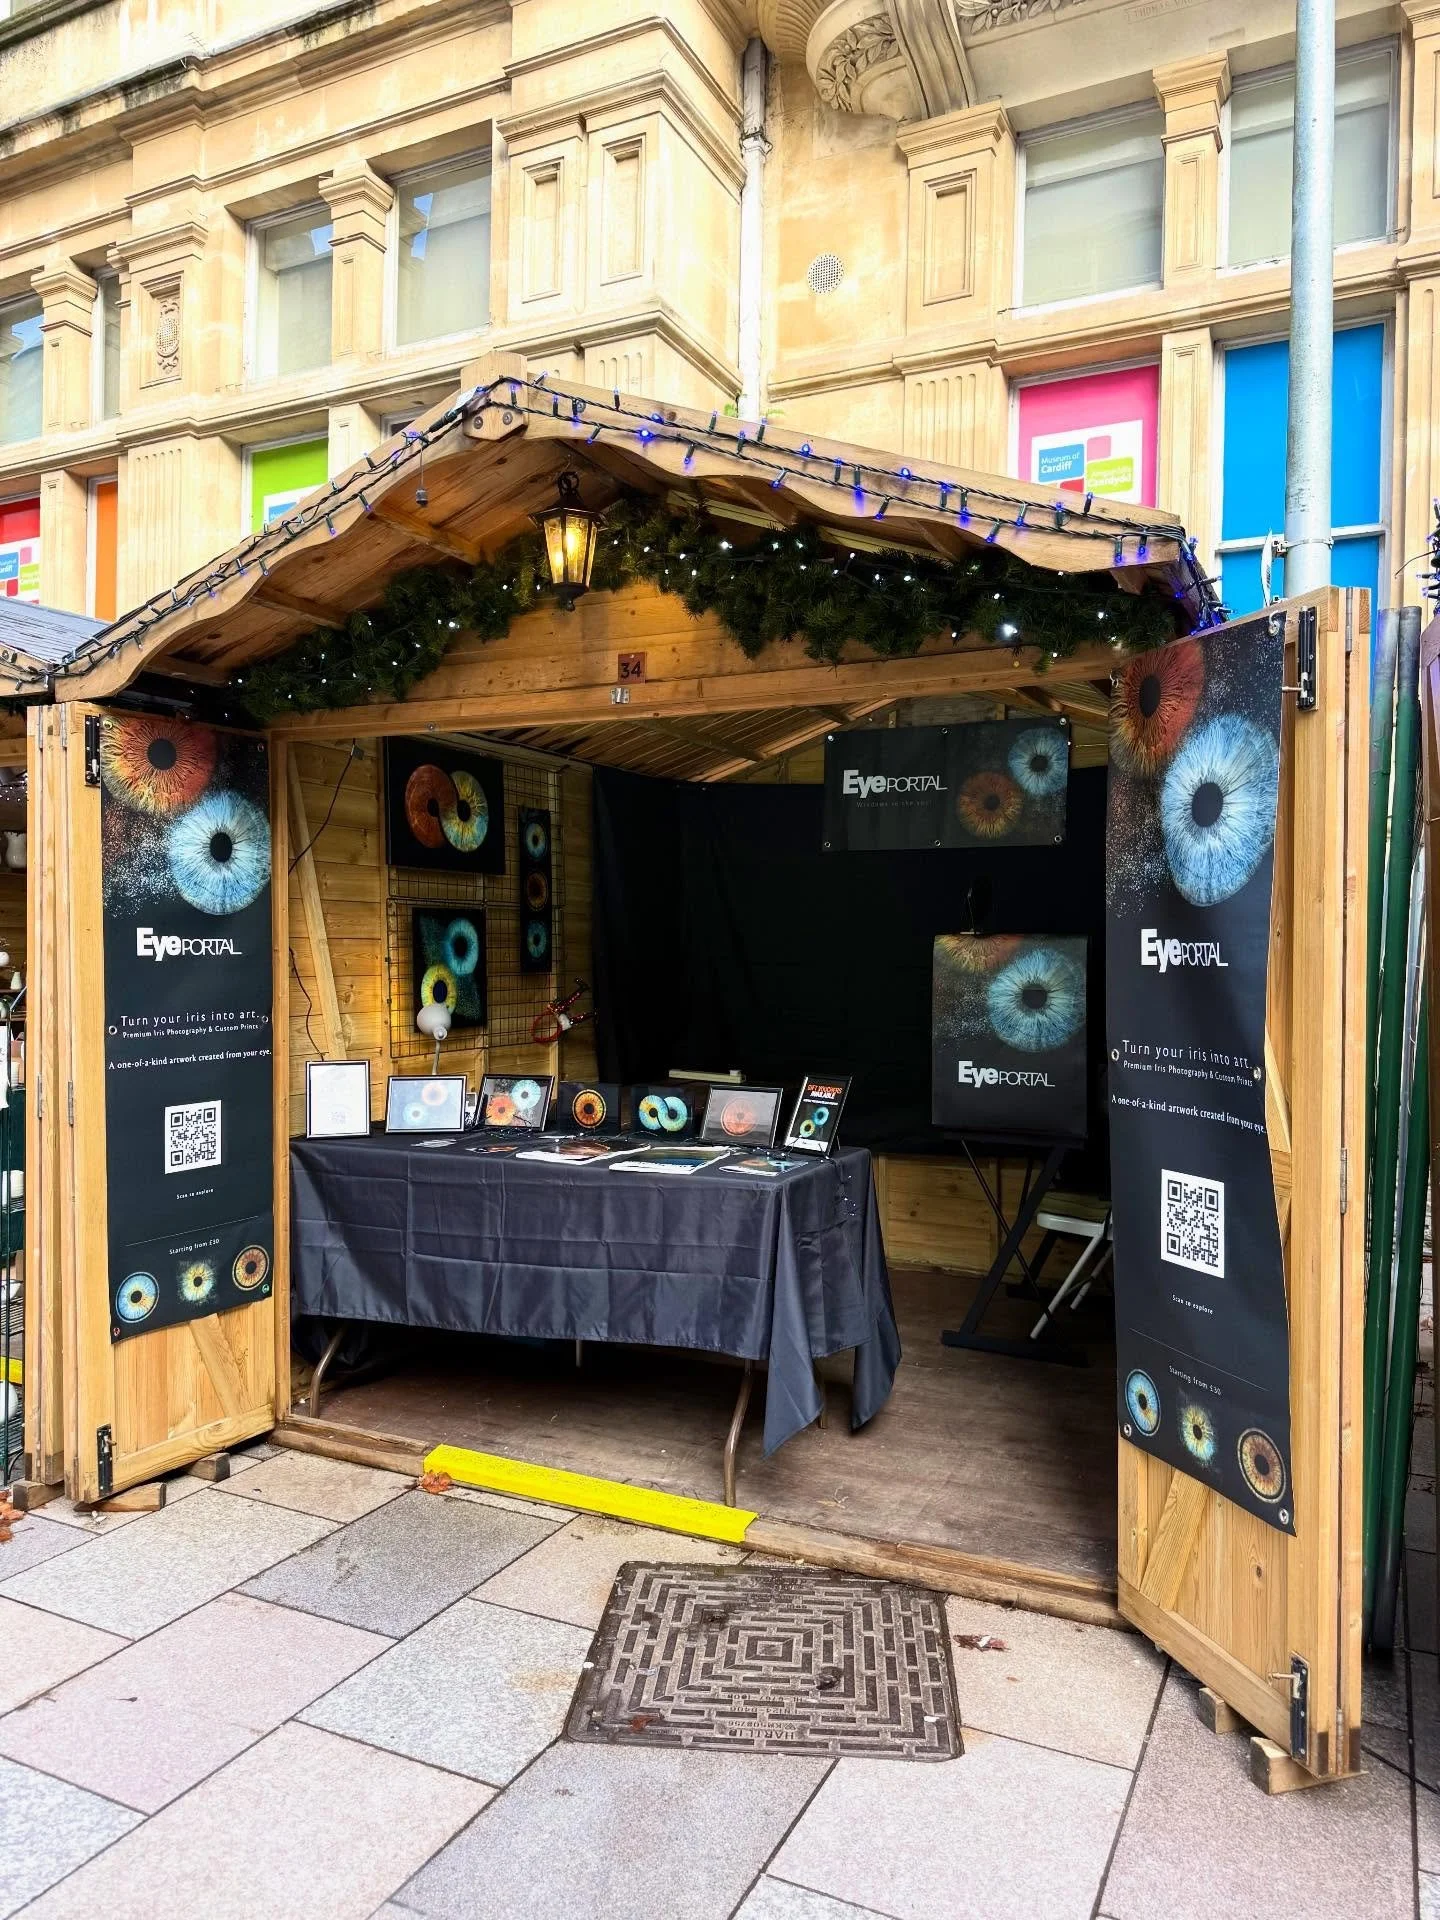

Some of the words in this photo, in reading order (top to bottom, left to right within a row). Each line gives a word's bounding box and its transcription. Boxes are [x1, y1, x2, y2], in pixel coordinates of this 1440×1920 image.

[1041, 454, 1071, 465] Museum
[1072, 452, 1080, 460] of
[1041, 461, 1073, 474] Cardiff
[620, 661, 642, 679] 34
[120, 1015, 148, 1027] Turn
[153, 1014, 181, 1028] your
[186, 1012, 206, 1023] iris
[211, 1011, 235, 1021] into
[239, 1010, 260, 1020] art.
[122, 1031, 152, 1039] Premium
[166, 1026, 207, 1036] Photography
[215, 1024, 239, 1032] Custom
[108, 1061, 115, 1070] A
[117, 1057, 168, 1069] one-of-a-kind
[169, 1054, 197, 1064] artwork
[198, 1051, 225, 1061] created
[225, 1050, 242, 1059] from
[242, 1050, 258, 1059] your
[259, 1048, 272, 1057] eye.
[1122, 1039, 1150, 1055] Turn
[1155, 1046, 1184, 1060] your
[1188, 1046, 1207, 1062] iris
[1210, 1049, 1230, 1065] into
[1233, 1056, 1253, 1069] art.
[1123, 1060, 1152, 1071] Premium
[1154, 1063, 1166, 1073] Iris
[1168, 1064, 1208, 1080] Photography
[1214, 1071, 1236, 1083] Custom
[1236, 1075, 1253, 1087] Prints
[1112, 1094, 1117, 1104] A
[1117, 1097, 1166, 1112] one-of-a-kind
[1168, 1103, 1199, 1117] artwork
[1199, 1109, 1225, 1122] created
[1226, 1112, 1240, 1125] from
[1240, 1119, 1253, 1131] your
[169, 1244, 193, 1255] Starting
[1172, 1294, 1184, 1304] Scan
[1192, 1303, 1213, 1315] explore
[1169, 1365, 1191, 1384] Starting
[1193, 1376, 1208, 1390] from
